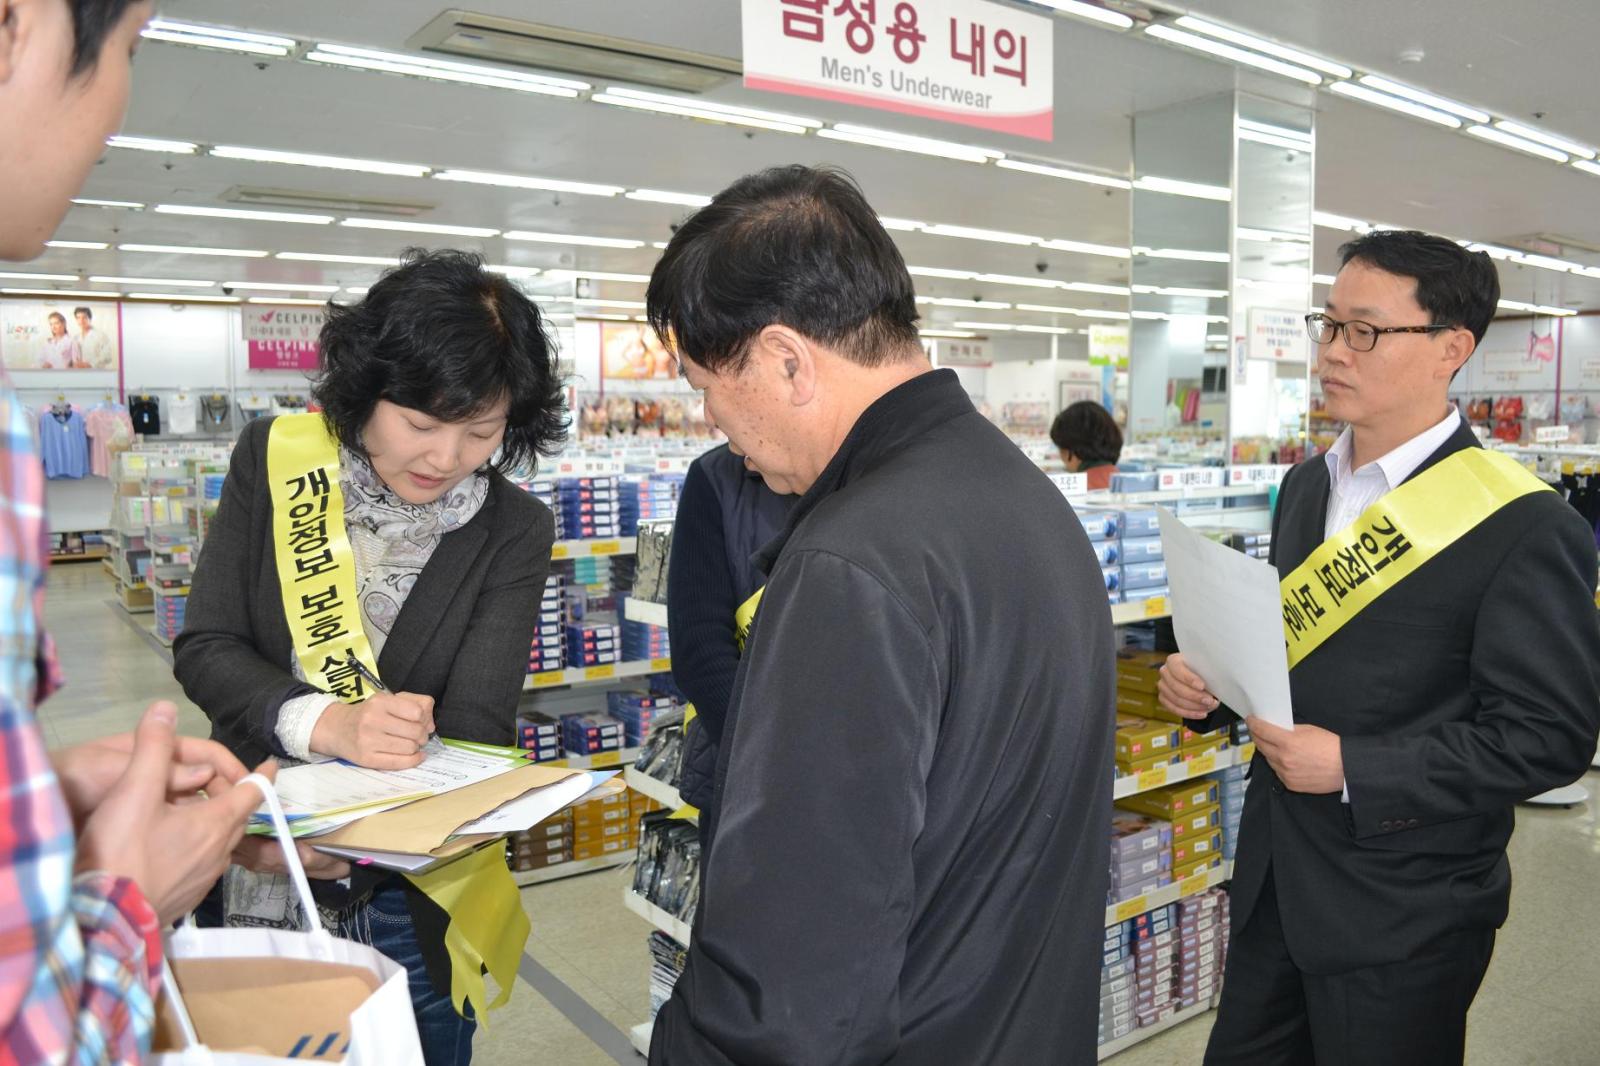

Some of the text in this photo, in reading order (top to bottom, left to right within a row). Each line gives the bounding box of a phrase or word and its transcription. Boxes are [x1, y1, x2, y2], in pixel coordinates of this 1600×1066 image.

[821, 56, 993, 109] Men's Underwear
[950, 17, 1027, 87] 내의
[285, 467, 340, 583] 개인정보
[1282, 515, 1413, 642] 개인정보 보호
[300, 584, 350, 648] 보호
